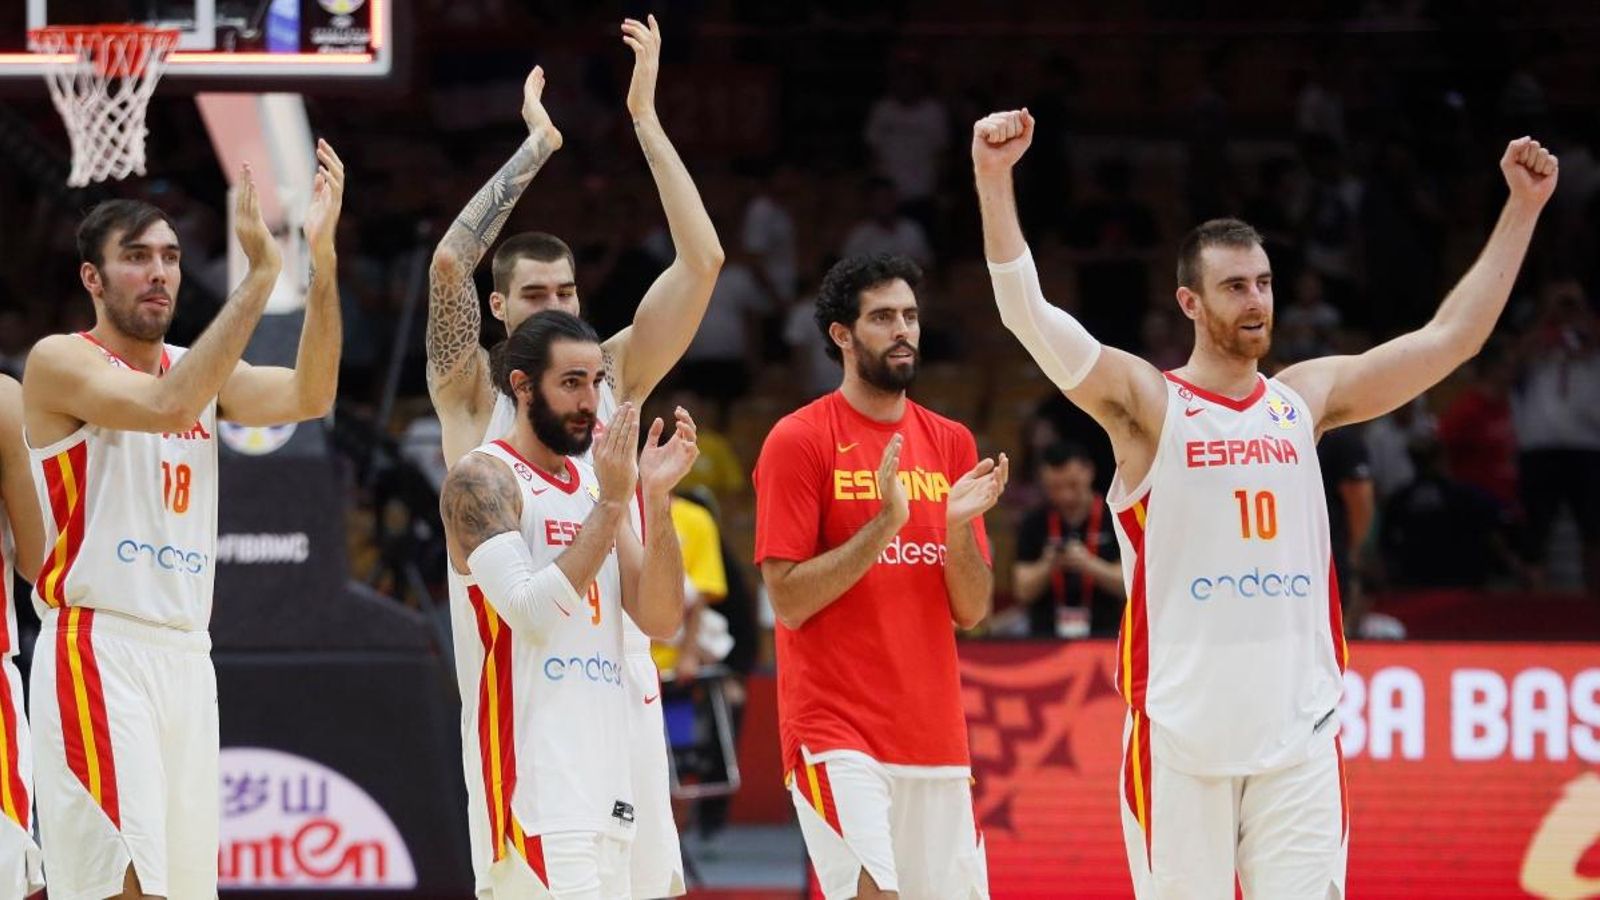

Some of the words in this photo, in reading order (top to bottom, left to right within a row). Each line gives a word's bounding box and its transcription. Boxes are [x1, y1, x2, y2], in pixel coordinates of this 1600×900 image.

[1186, 434, 1298, 468] ESPAÑA
[162, 461, 191, 514] 18
[834, 466, 951, 502] ESAÑA
[1235, 490, 1277, 540] 10
[586, 579, 601, 626] 9
[1191, 567, 1311, 600] endesa
[218, 818, 385, 879] nten
